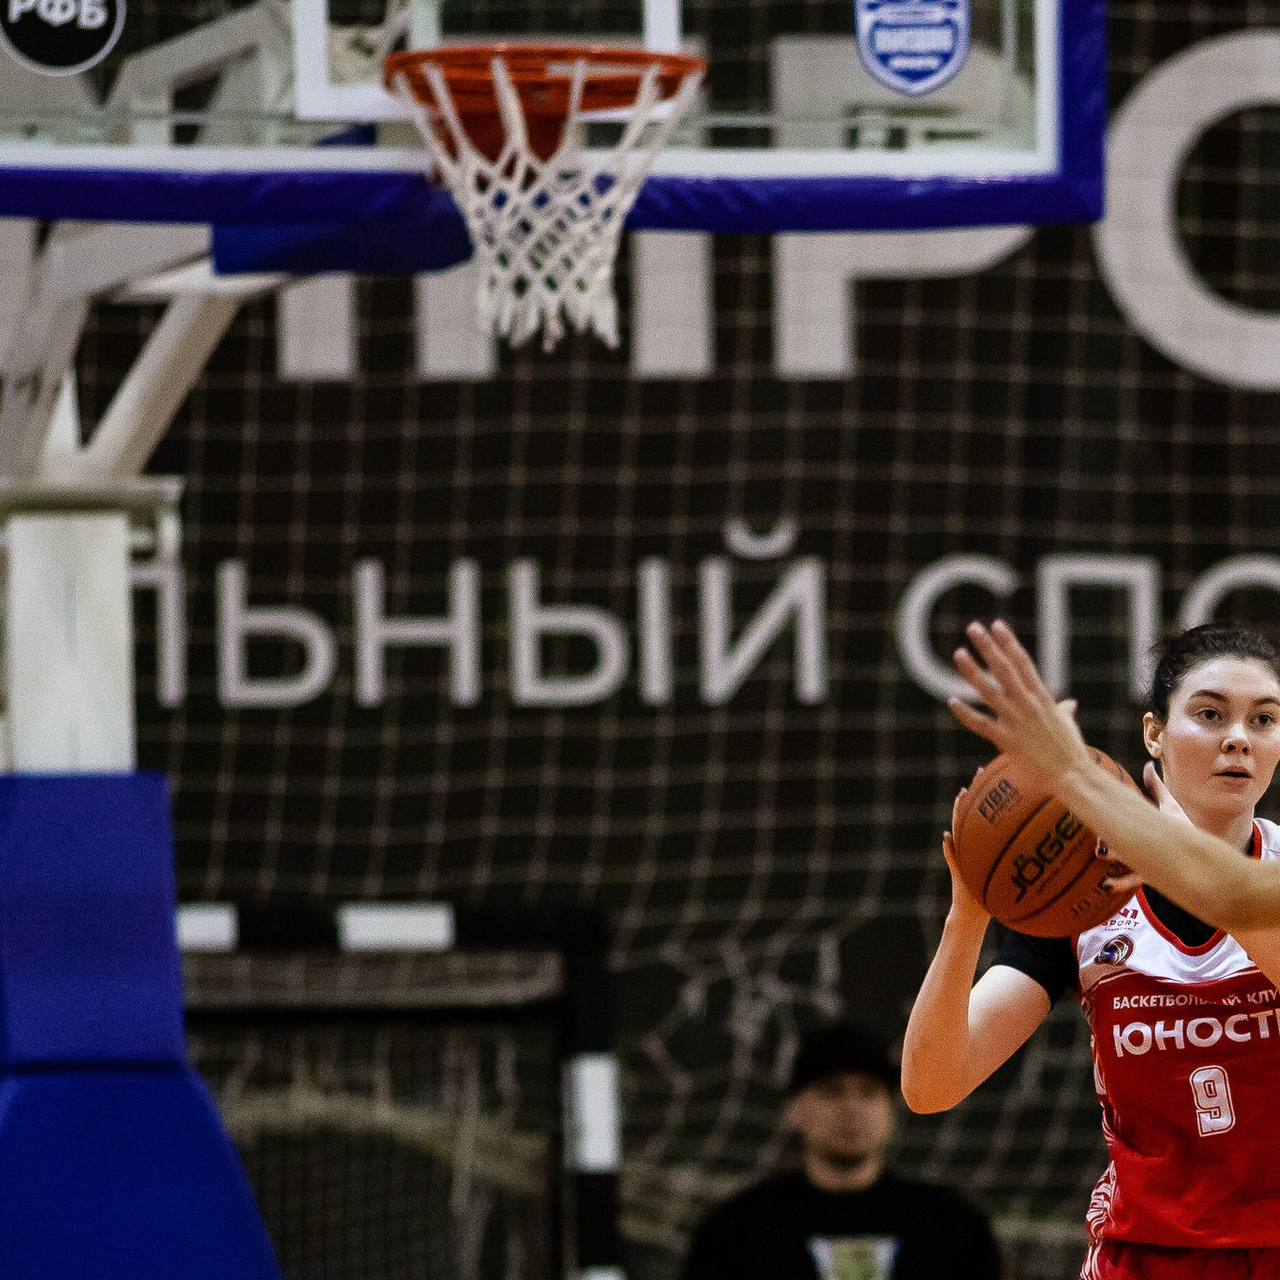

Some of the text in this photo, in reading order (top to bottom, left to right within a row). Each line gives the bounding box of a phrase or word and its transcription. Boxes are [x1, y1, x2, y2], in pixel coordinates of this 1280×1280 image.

[1010, 808, 1083, 904] JÖGE
[1103, 919, 1140, 928] PORT
[1113, 993, 1242, 1010] БАСКЕТБОЛЬЙ
[1189, 1064, 1236, 1138] 9
